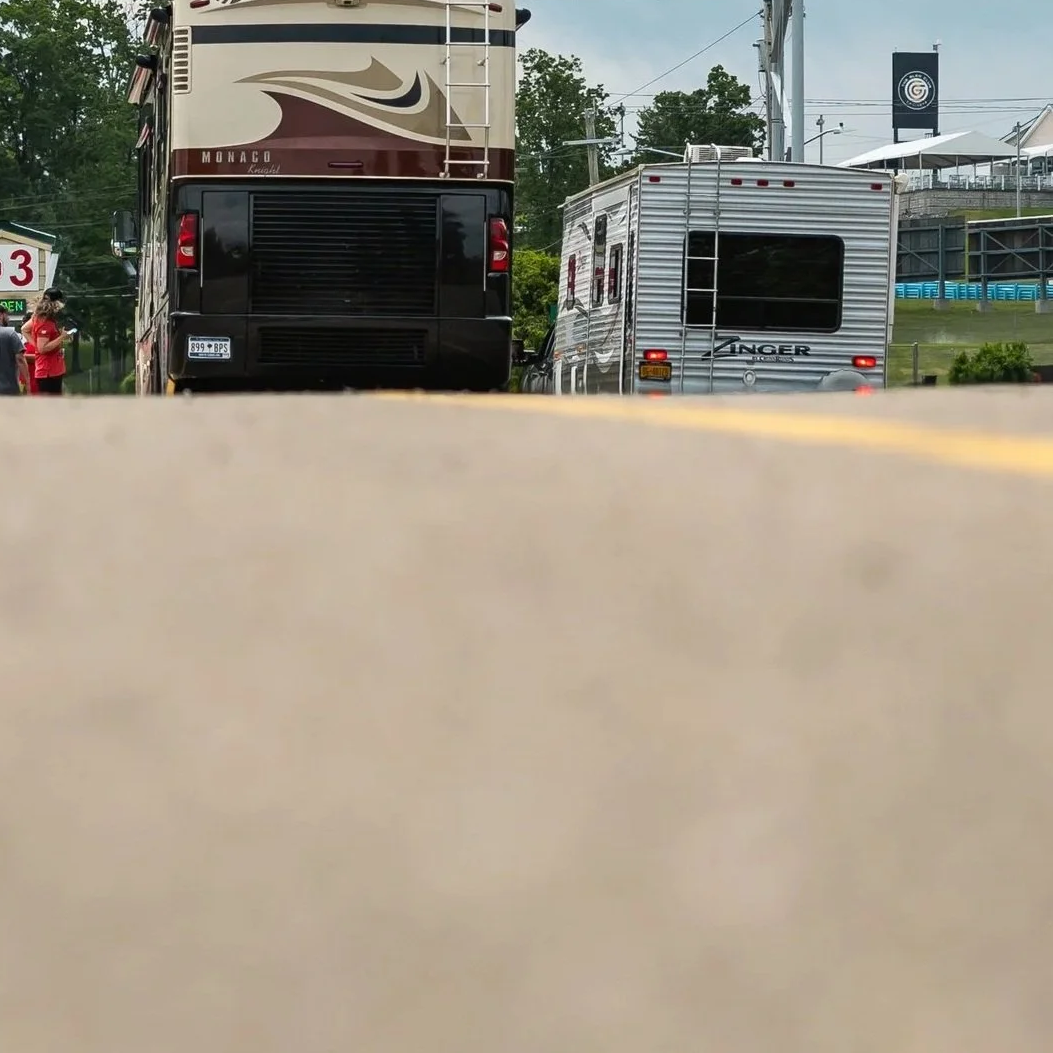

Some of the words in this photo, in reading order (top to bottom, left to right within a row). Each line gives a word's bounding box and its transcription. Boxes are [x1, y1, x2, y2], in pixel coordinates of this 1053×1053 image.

[202, 150, 271, 163] MONACO
[247, 163, 281, 178] Knight
[9, 249, 34, 287] 3
[190, 343, 205, 353] 899
[701, 335, 811, 361] ZINGER
